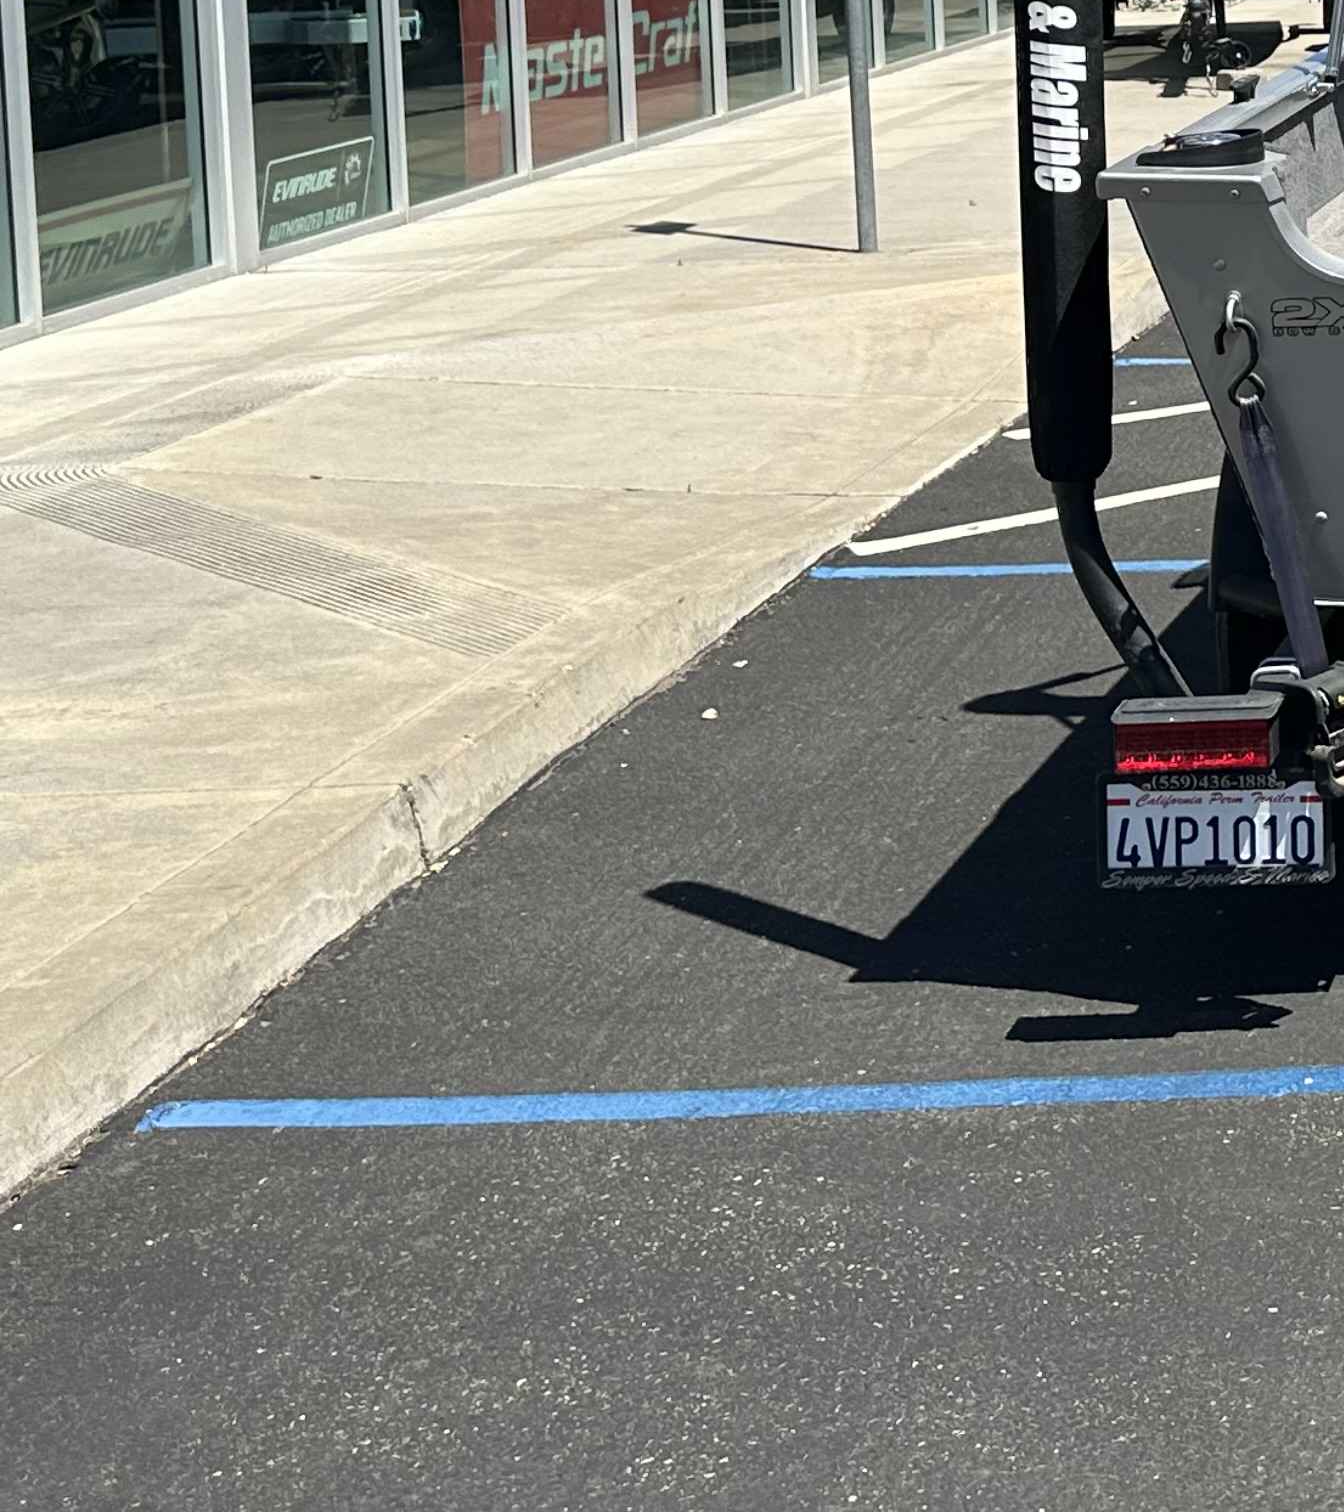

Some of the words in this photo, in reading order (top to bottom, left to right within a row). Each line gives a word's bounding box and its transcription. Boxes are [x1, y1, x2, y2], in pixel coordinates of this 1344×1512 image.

[1027, 0, 1078, 34] &
[1029, 39, 1089, 194] Marine
[1135, 793, 1203, 808] California
[1208, 792, 1244, 805] Perm
[1253, 791, 1296, 804] Trailer
[1115, 814, 1316, 867] 4VP1010
